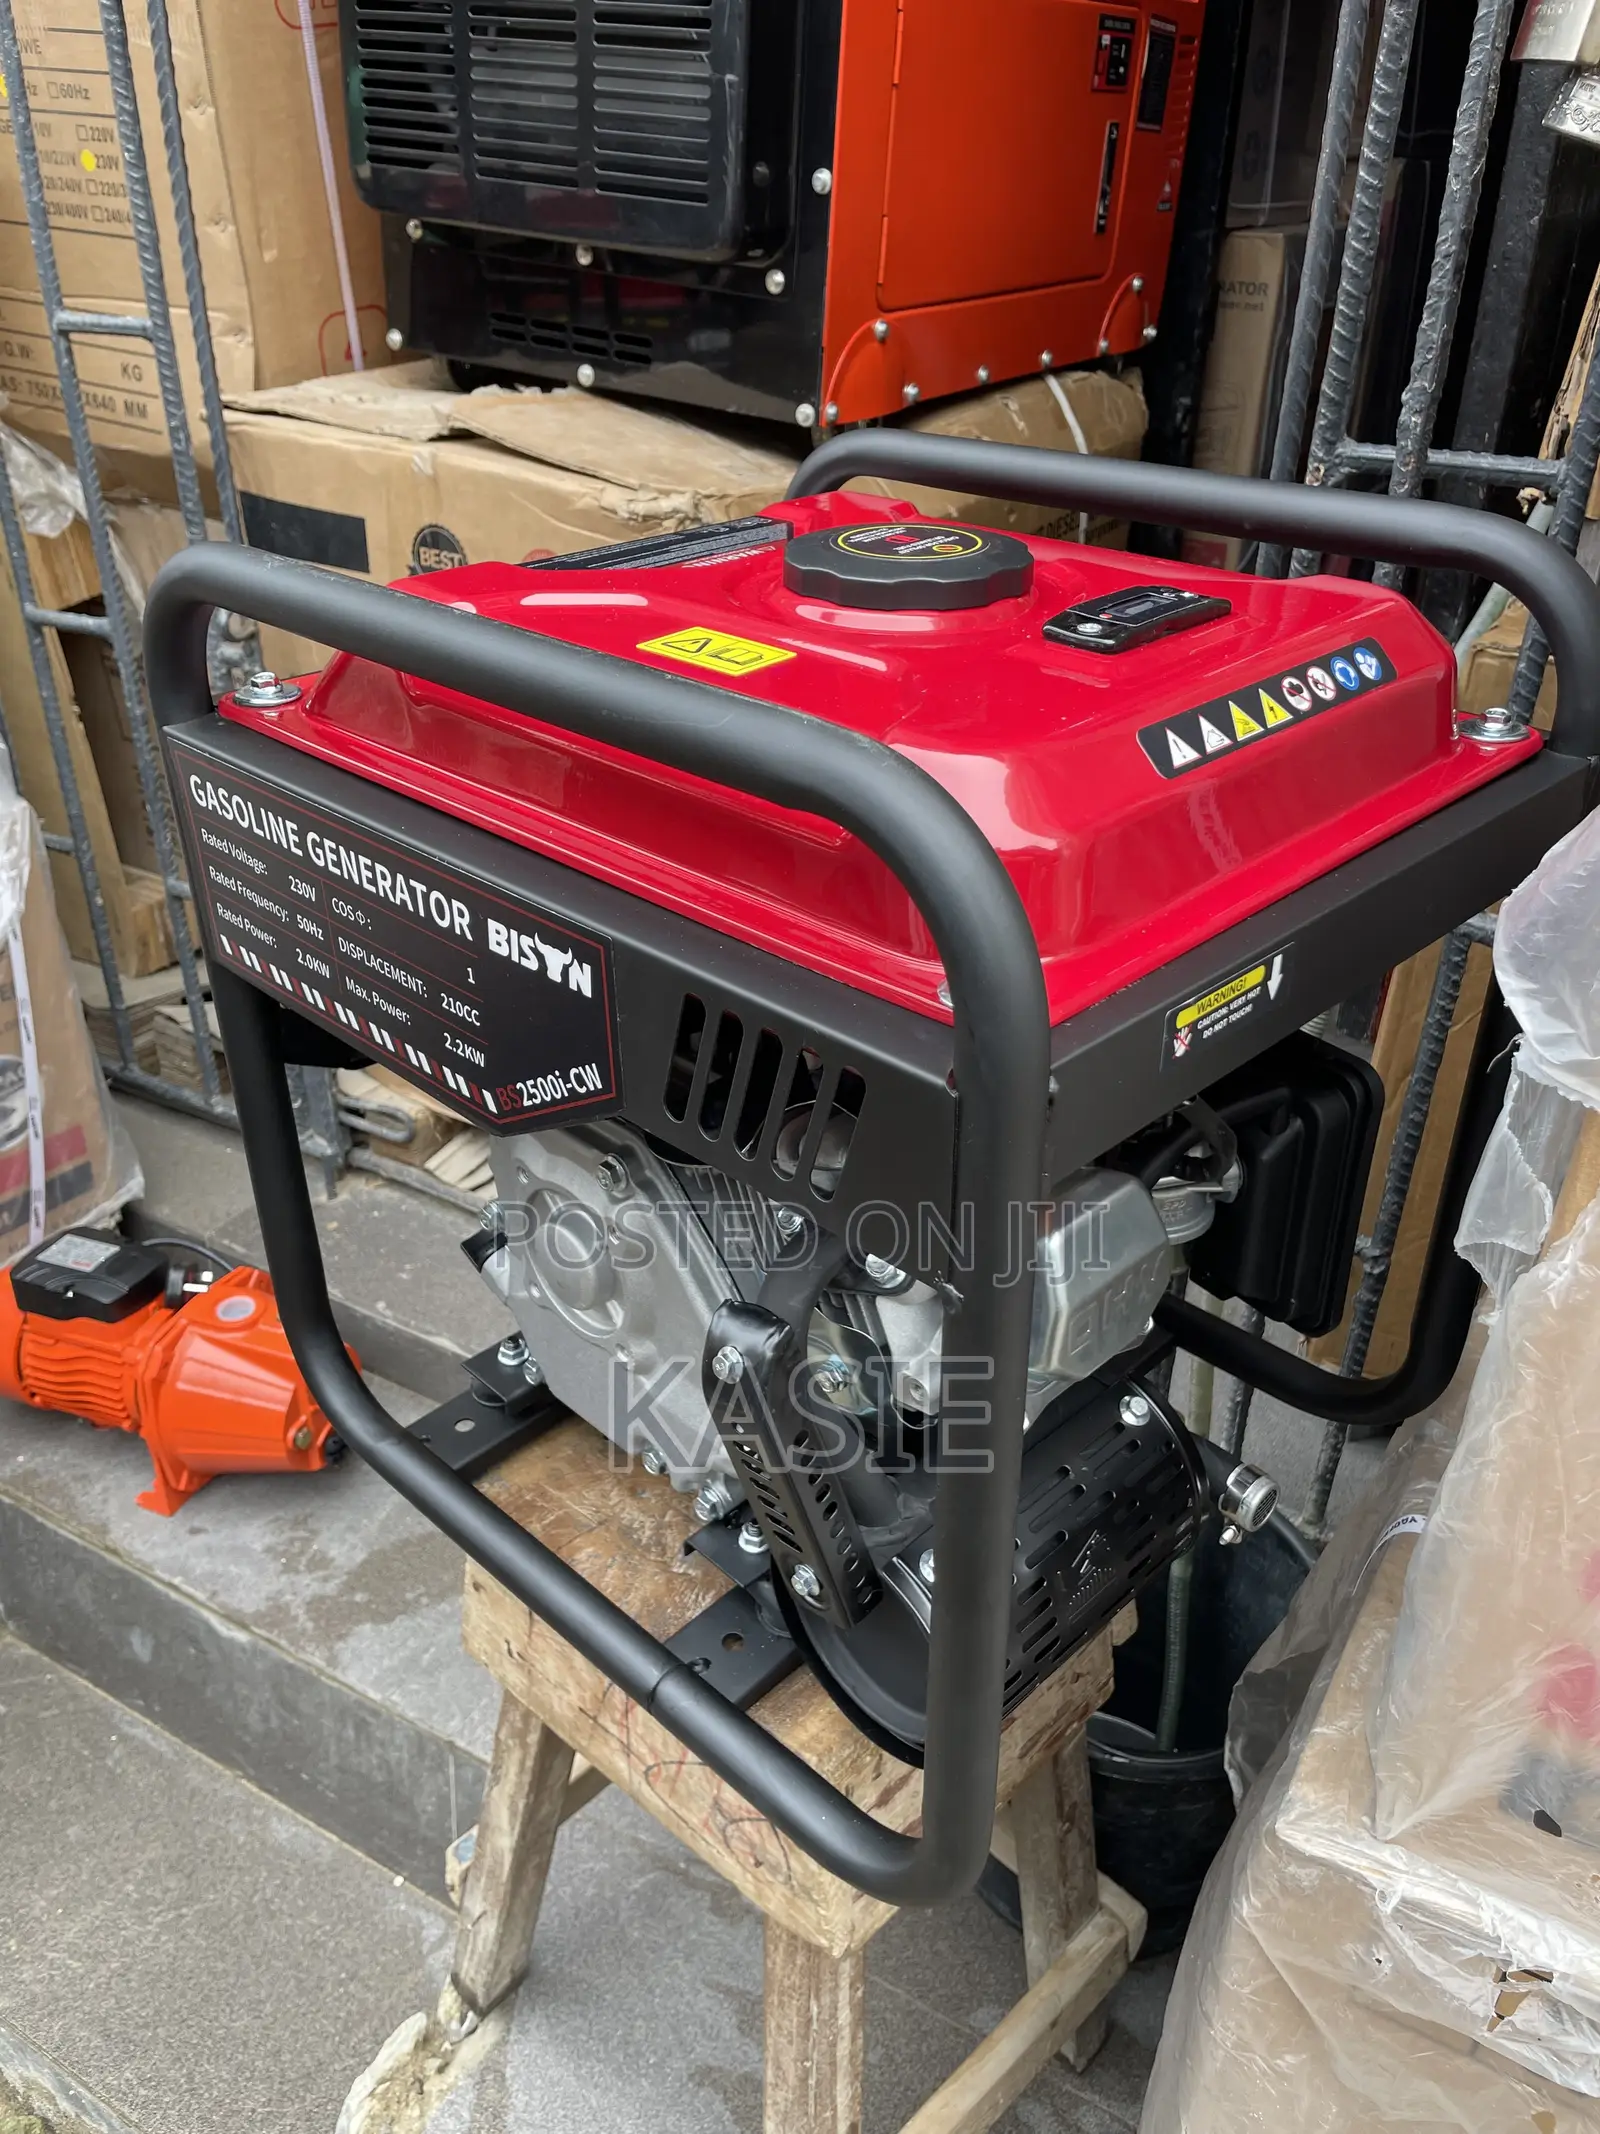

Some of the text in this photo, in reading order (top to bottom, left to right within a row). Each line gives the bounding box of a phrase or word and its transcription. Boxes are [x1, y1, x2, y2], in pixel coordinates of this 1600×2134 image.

[59, 85, 90, 100] 60Hz
[121, 362, 143, 382] KG
[419, 546, 464, 570] BEST
[189, 774, 303, 857] GASOLINE
[306, 831, 473, 942] GENERATOR
[201, 828, 268, 874] Rated Voltage:
[209, 866, 290, 922] Rated Frequency:
[288, 875, 316, 902] 230V
[217, 902, 278, 949] Rated Power:
[297, 914, 324, 941] 50Hz
[295, 948, 330, 979] 2.0KW
[338, 936, 428, 998] DISPLACEMENT:
[467, 967, 475, 985] 1
[345, 975, 411, 1026] Max. Power:
[440, 993, 481, 1027] 210CC
[1196, 977, 1247, 1015] WARNING!
[1229, 996, 1247, 1011] VERY
[1246, 986, 1261, 1001] HOT
[1202, 1003, 1253, 1039] DO NOT TOUCH!
[443, 1032, 485, 1068] 2.2KW
[495, 1063, 603, 1111] BS2500i-CW
